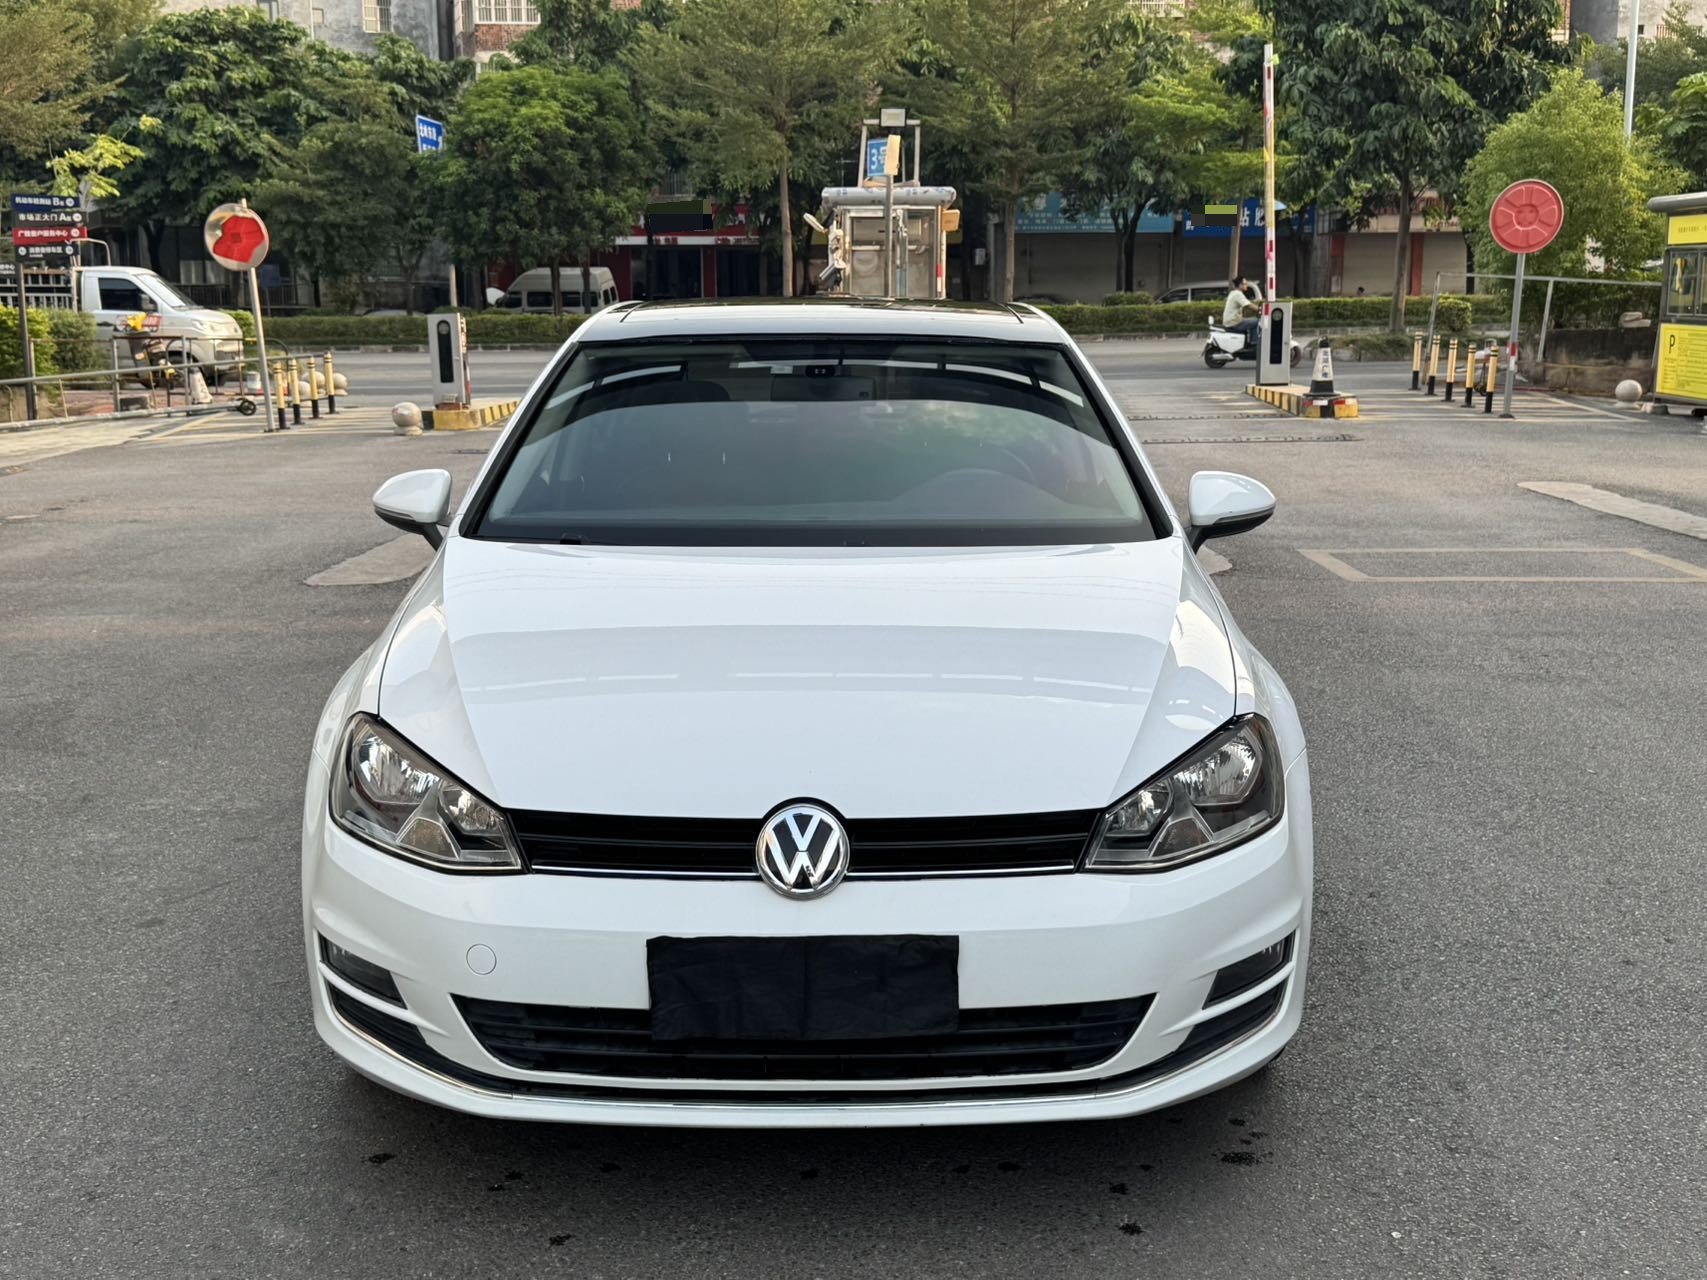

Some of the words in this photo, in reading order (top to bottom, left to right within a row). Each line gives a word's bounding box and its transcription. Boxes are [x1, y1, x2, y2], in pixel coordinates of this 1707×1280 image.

[18, 213, 58, 221] 市场正大门
[1668, 334, 1676, 354] P
